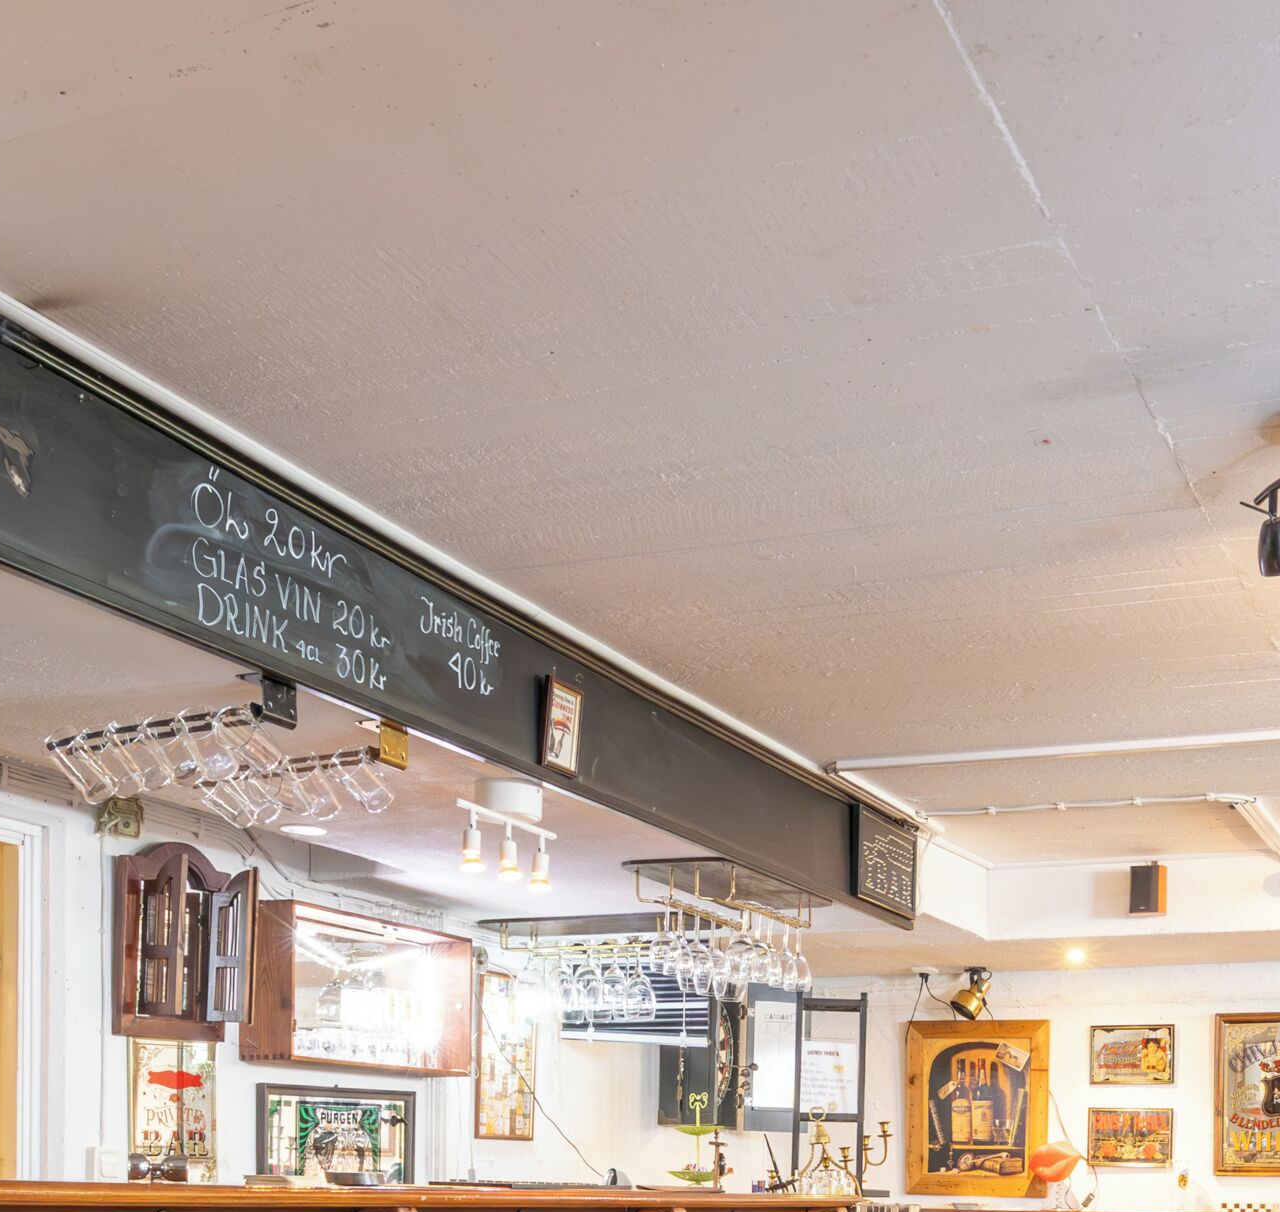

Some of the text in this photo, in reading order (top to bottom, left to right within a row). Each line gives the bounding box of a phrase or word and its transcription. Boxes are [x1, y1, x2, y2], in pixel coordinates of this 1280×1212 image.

[192, 537, 266, 597] GLAS
[275, 574, 321, 624] VIN
[198, 583, 288, 653] DRINK
[467, 618, 500, 665] Coffee
[320, 1112, 358, 1125] PURGEN
[143, 1130, 208, 1156] BAR
